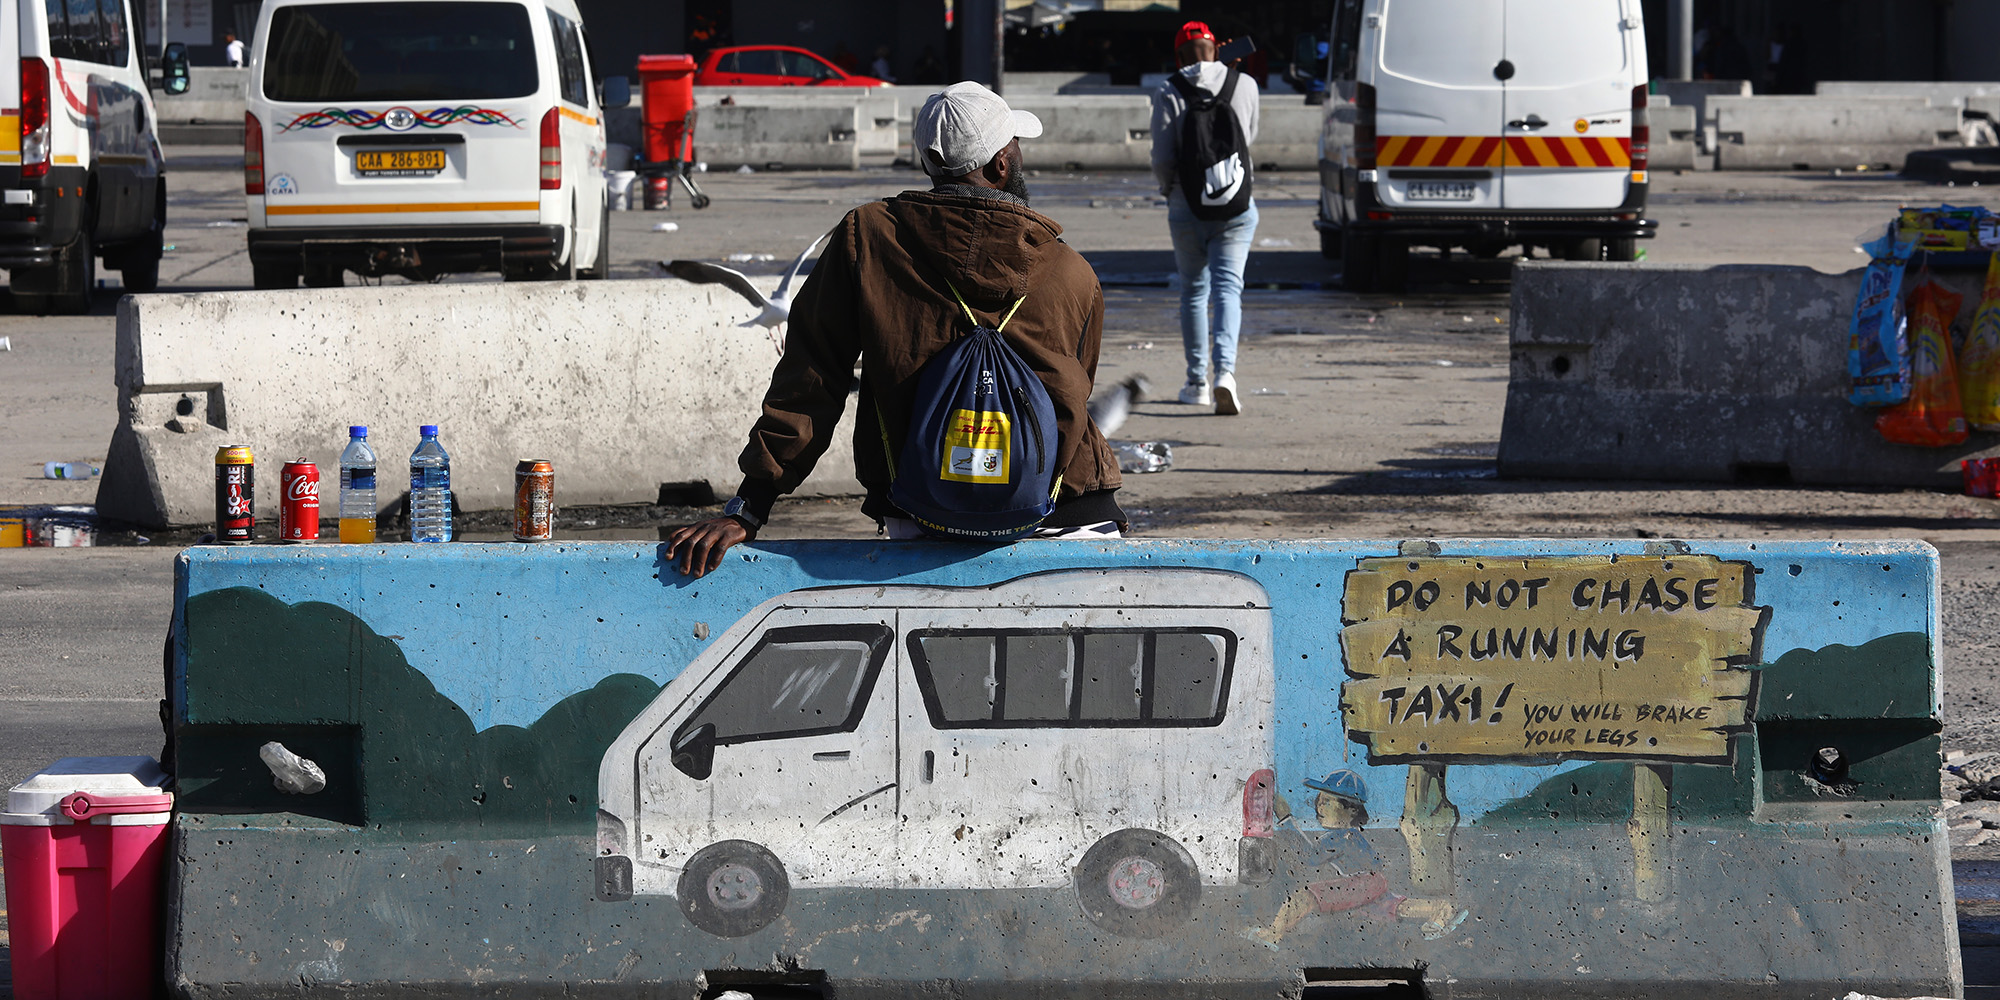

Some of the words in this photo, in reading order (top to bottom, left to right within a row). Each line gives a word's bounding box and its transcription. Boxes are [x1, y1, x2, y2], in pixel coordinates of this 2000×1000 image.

[360, 153, 383, 167] CAA
[391, 152, 440, 167] 286-891
[960, 424, 997, 435] DHL
[917, 516, 946, 532] TEAM
[947, 527, 990, 537] BEHIND
[991, 528, 1013, 537] THE
[1386, 578, 1442, 614] DO
[1464, 577, 1551, 612] NOT
[1571, 577, 1721, 614] CHASE
[1381, 626, 1413, 663] A
[1436, 625, 1647, 664] RUNNING
[1380, 682, 1516, 726] TAXI!
[1523, 703, 1564, 730] YOU
[1570, 702, 1624, 723] WILL
[1635, 702, 1713, 725] BRAKE
[1523, 728, 1577, 749] YOUR
